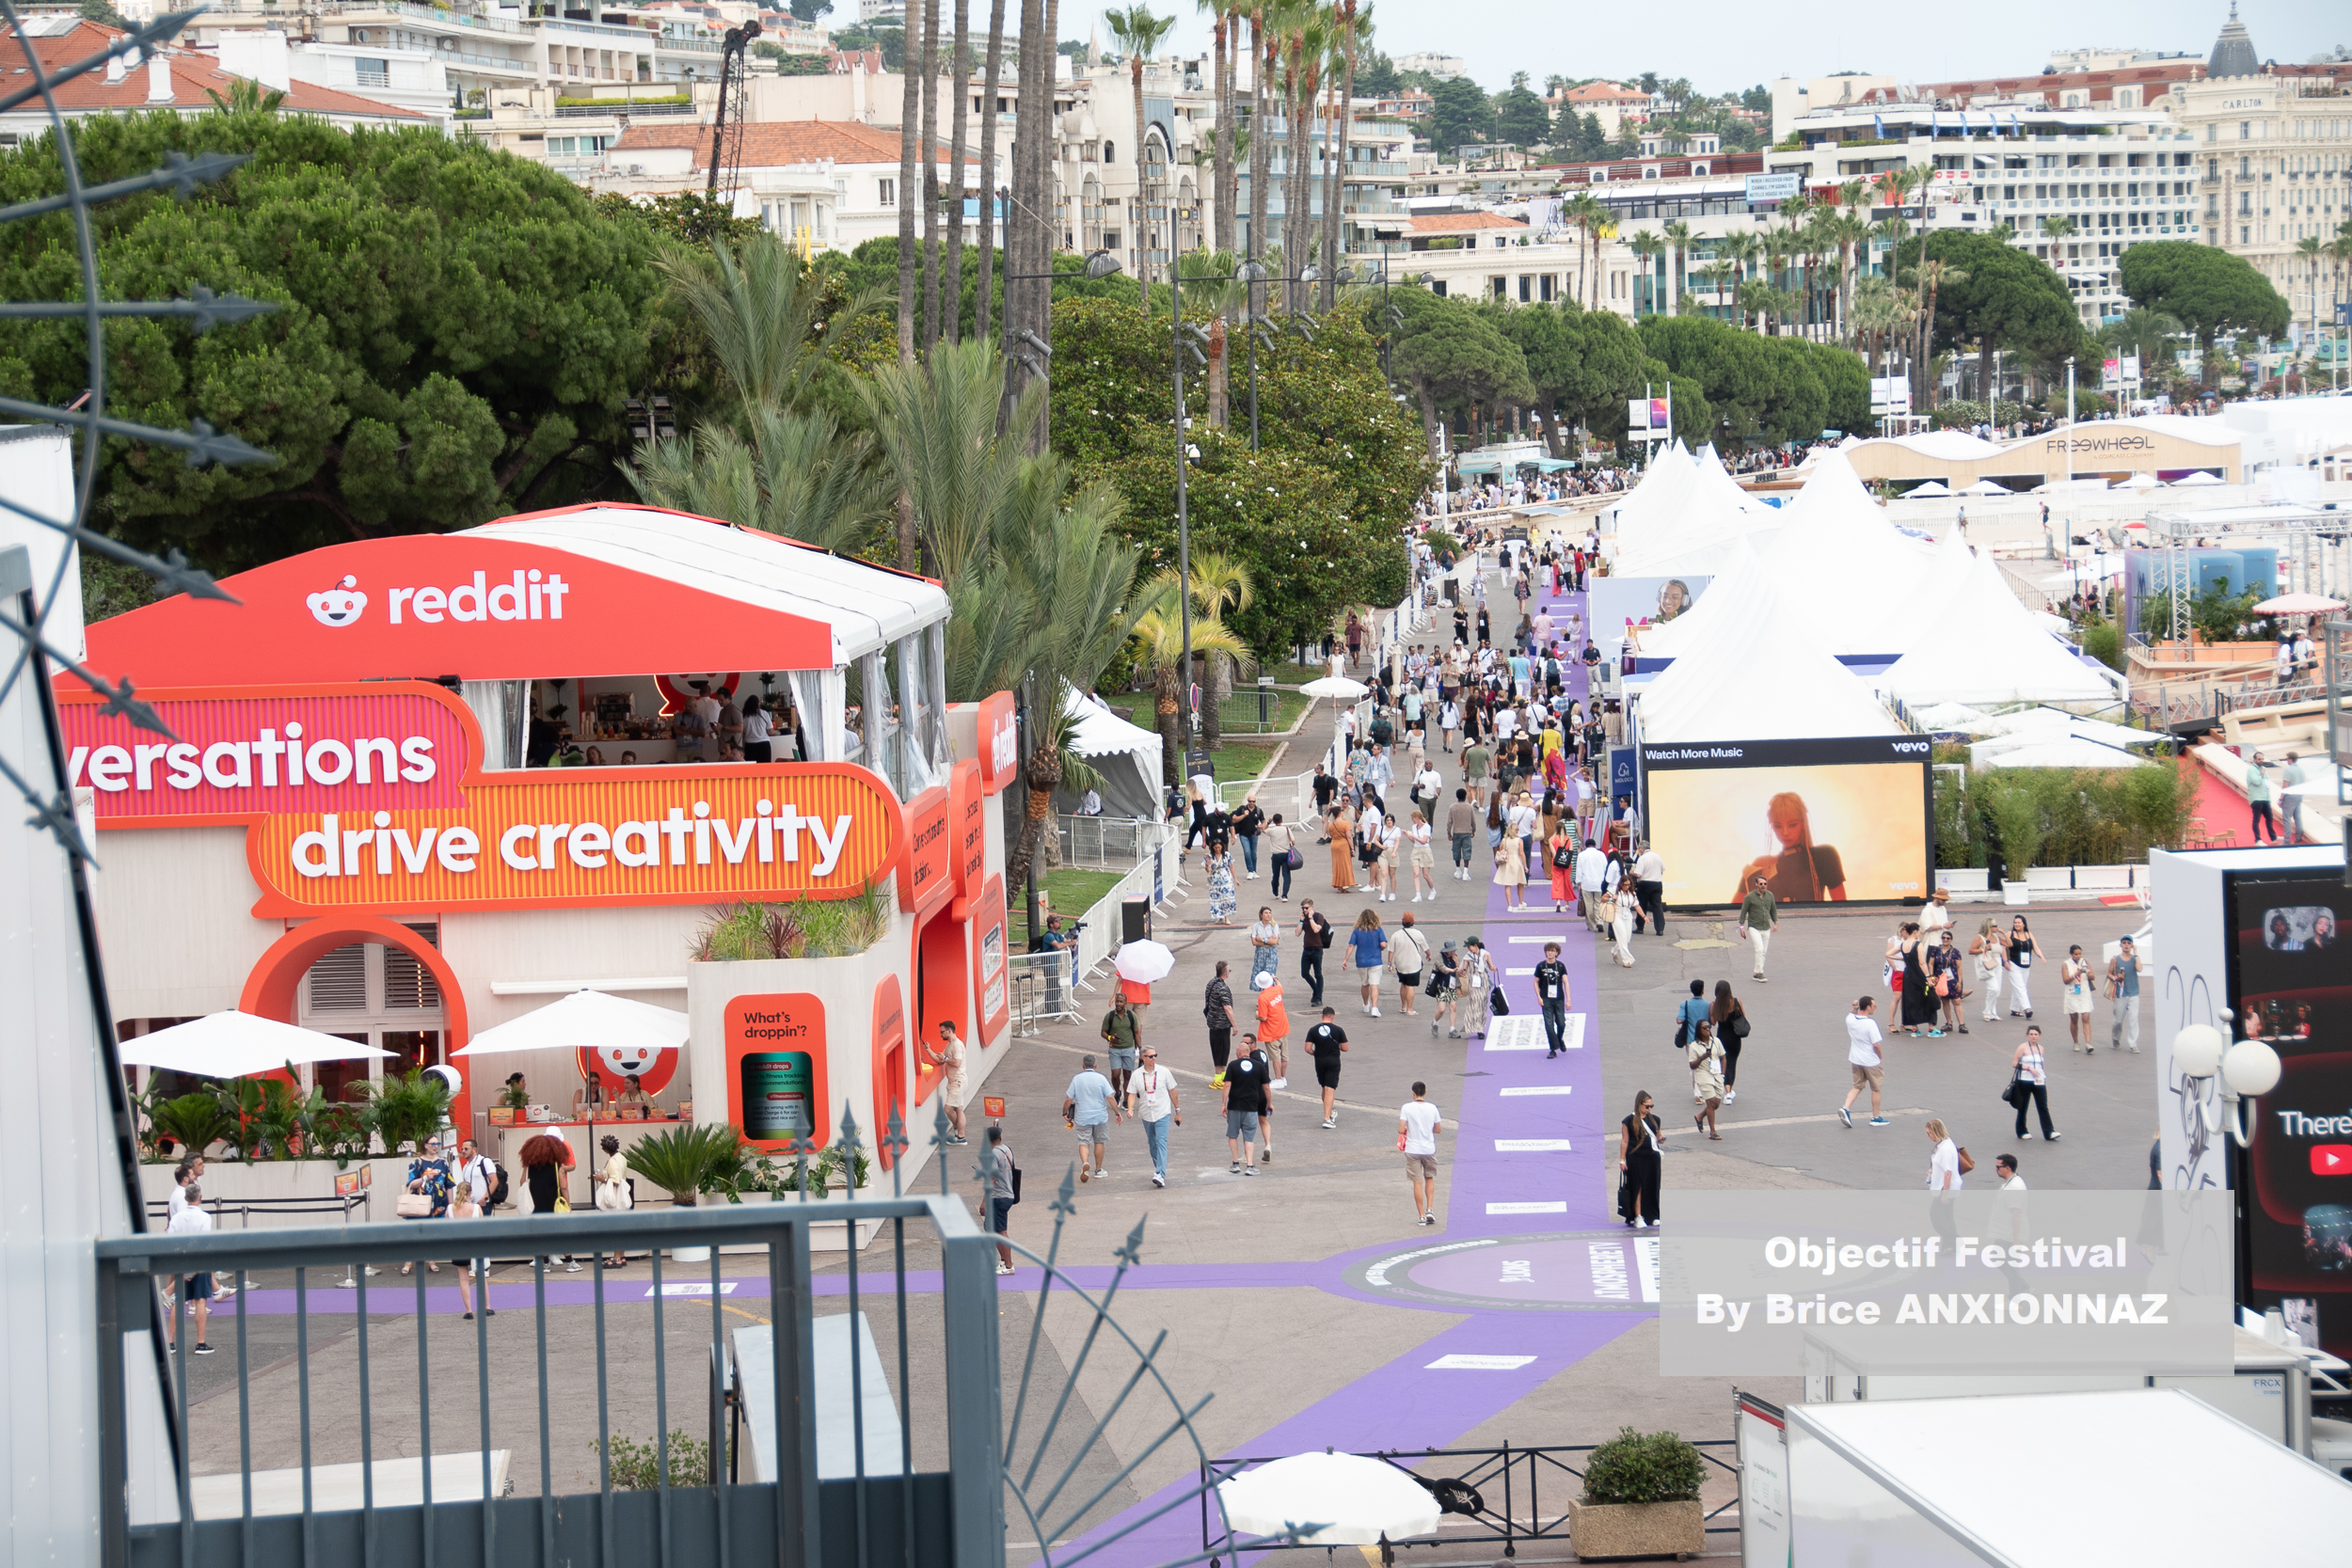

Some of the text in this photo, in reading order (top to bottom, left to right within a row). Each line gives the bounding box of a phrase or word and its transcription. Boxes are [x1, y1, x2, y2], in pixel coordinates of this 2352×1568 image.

[2223, 99, 2262, 109] CARLTON
[389, 569, 569, 625] reddit
[1891, 742, 1929, 752] vevo
[1645, 747, 1743, 760] Watch More Music
[292, 798, 853, 878] drive creativity
[1889, 881, 1919, 891] vevo
[744, 1012, 791, 1024] What's
[1502, 1260, 1531, 1278] LIONS
